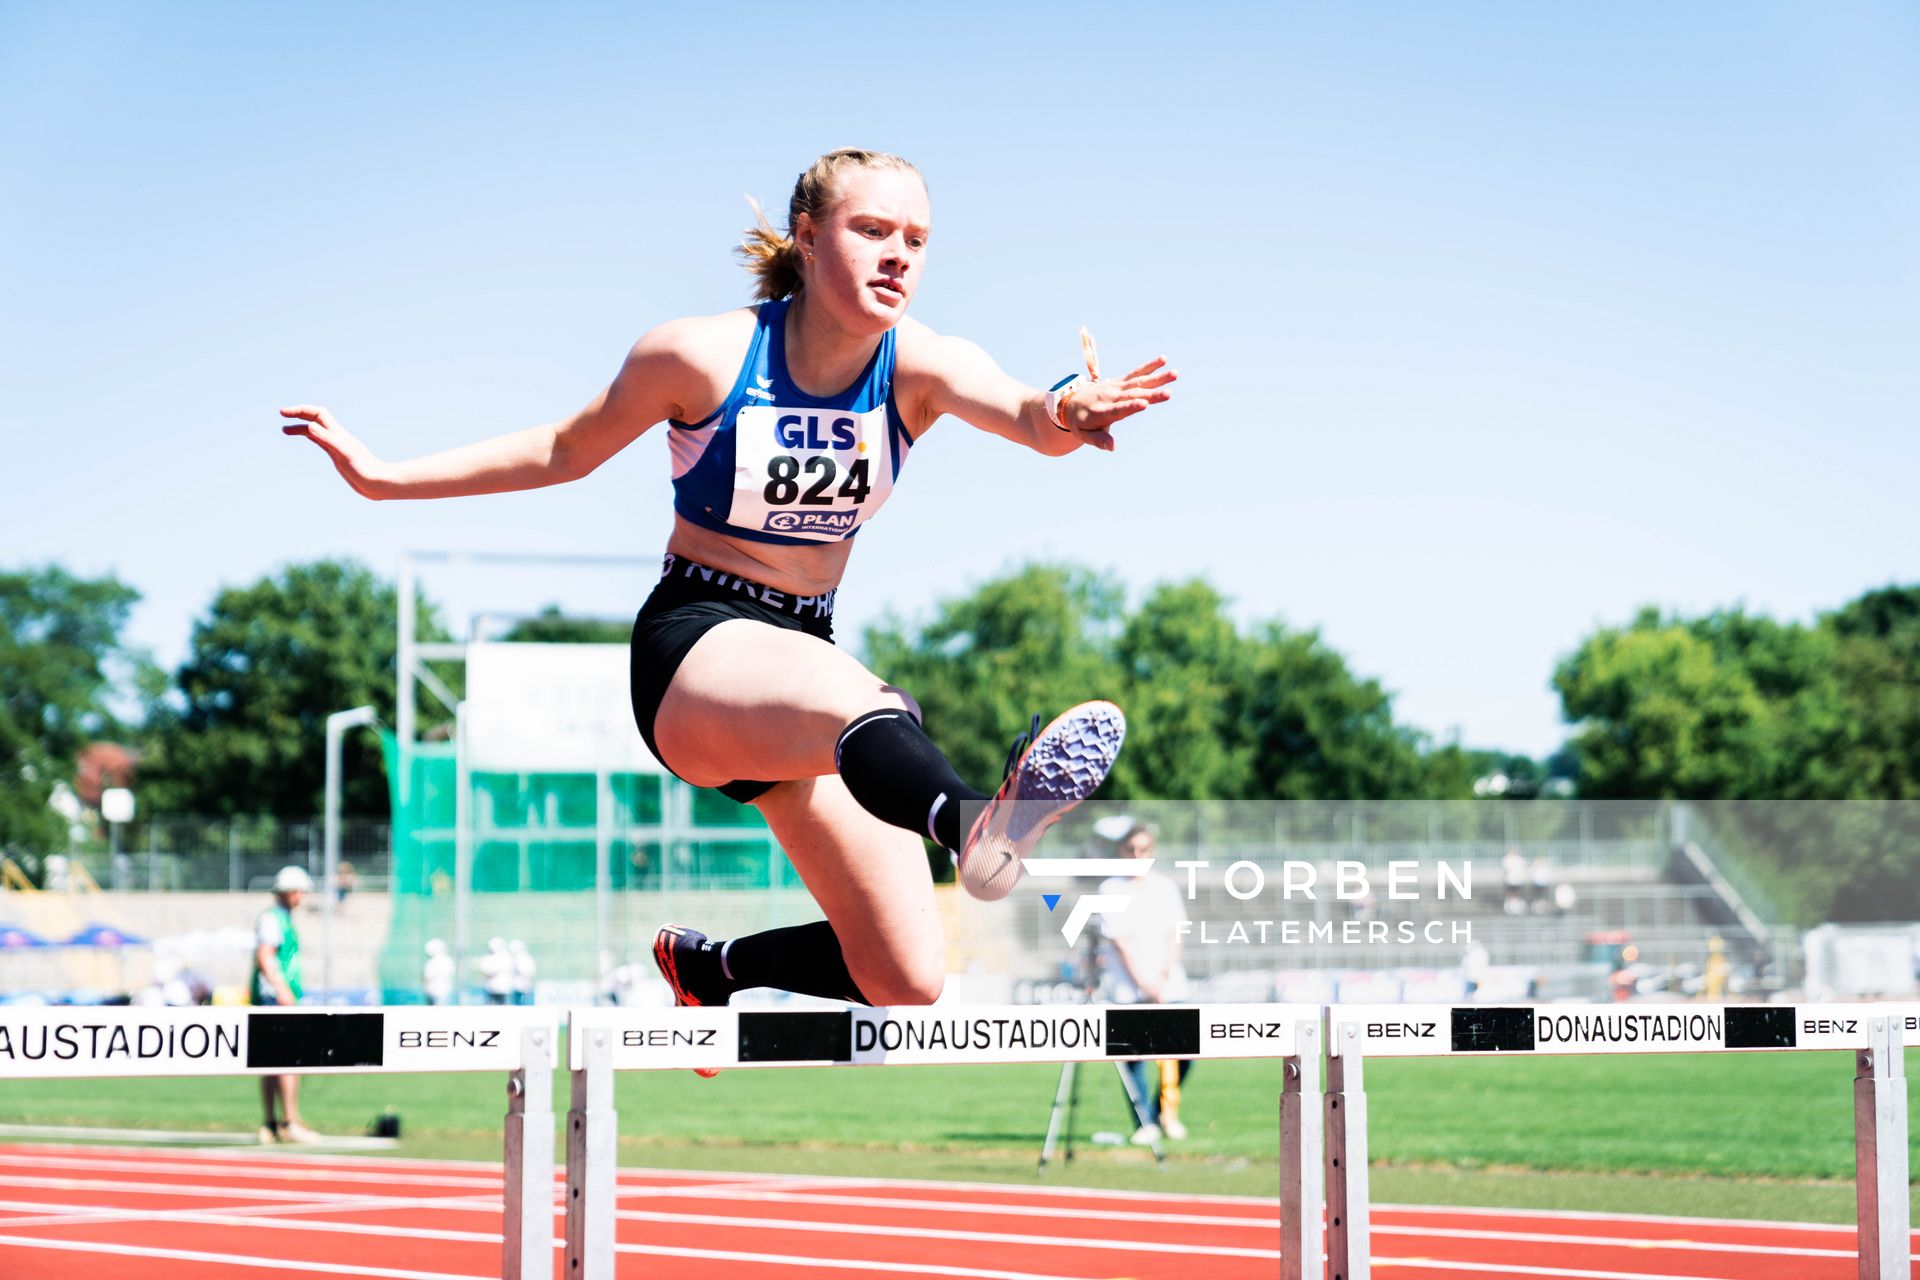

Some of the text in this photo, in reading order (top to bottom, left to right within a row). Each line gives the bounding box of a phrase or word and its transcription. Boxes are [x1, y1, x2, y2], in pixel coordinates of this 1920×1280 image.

[763, 455, 871, 506] 824
[802, 514, 854, 527] PLAN
[399, 1030, 500, 1048] BENZ
[623, 1018, 1281, 1052] BENZ DONAUSTADION BENZ
[1367, 1014, 1858, 1043] BENZ DONAUSTADION BENZ
